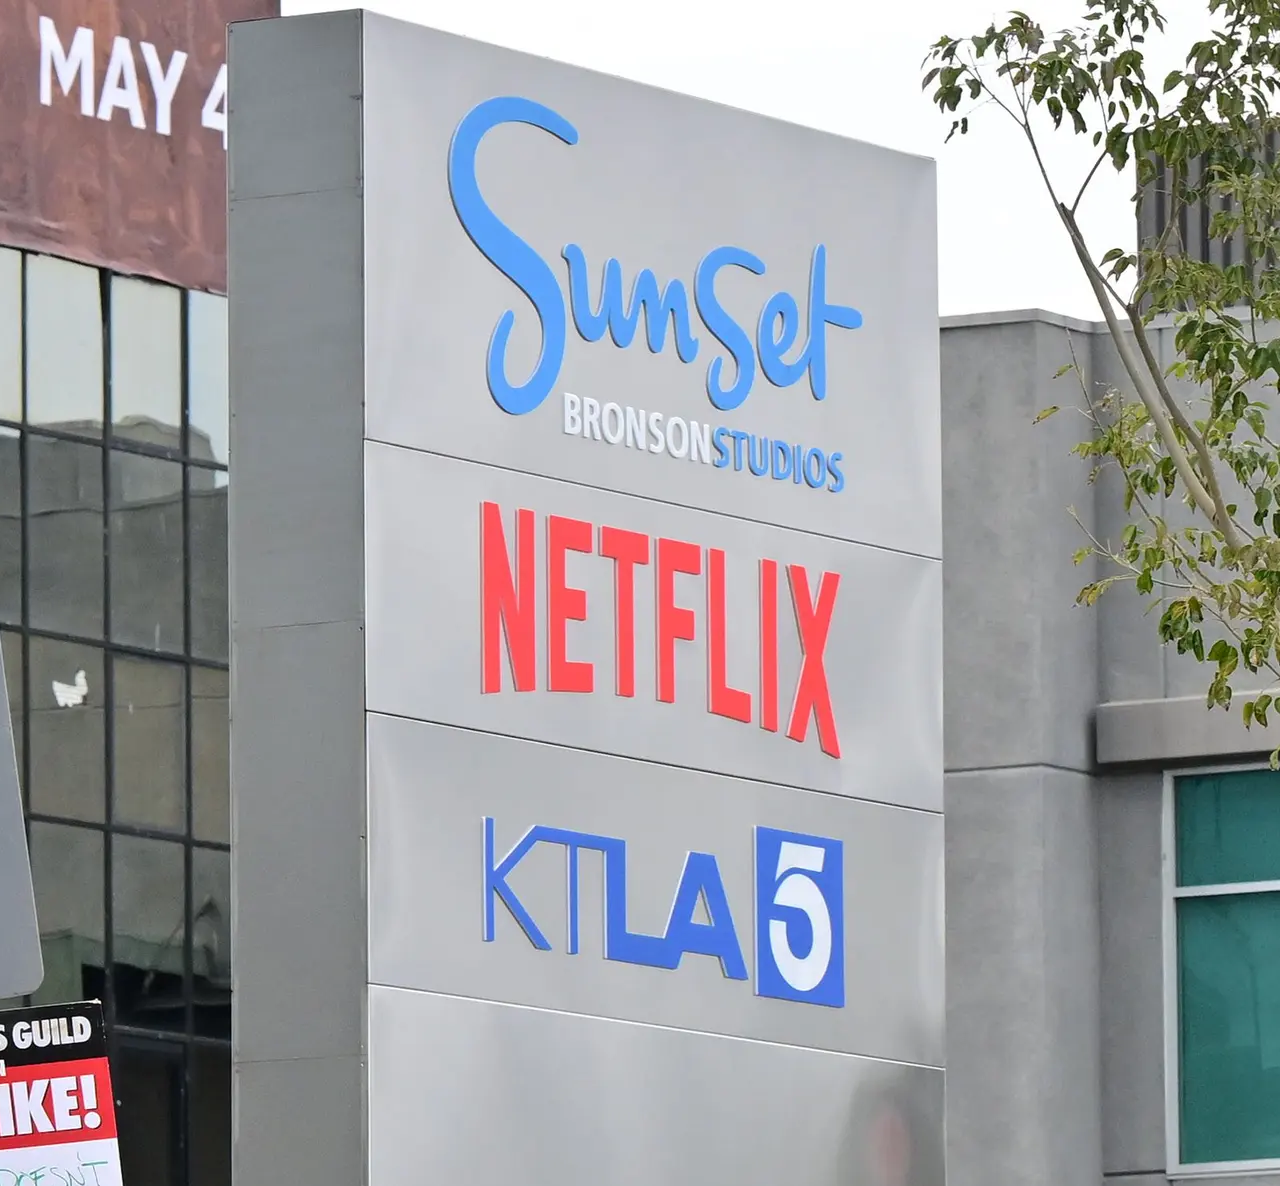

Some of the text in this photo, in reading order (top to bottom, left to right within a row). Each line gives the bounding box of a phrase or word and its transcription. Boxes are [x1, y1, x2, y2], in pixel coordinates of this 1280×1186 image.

[39, 14, 188, 136] MAY
[480, 500, 841, 759] NETFLIX
[481, 816, 748, 981] KTLA
[12, 1016, 92, 1050] GUILD
